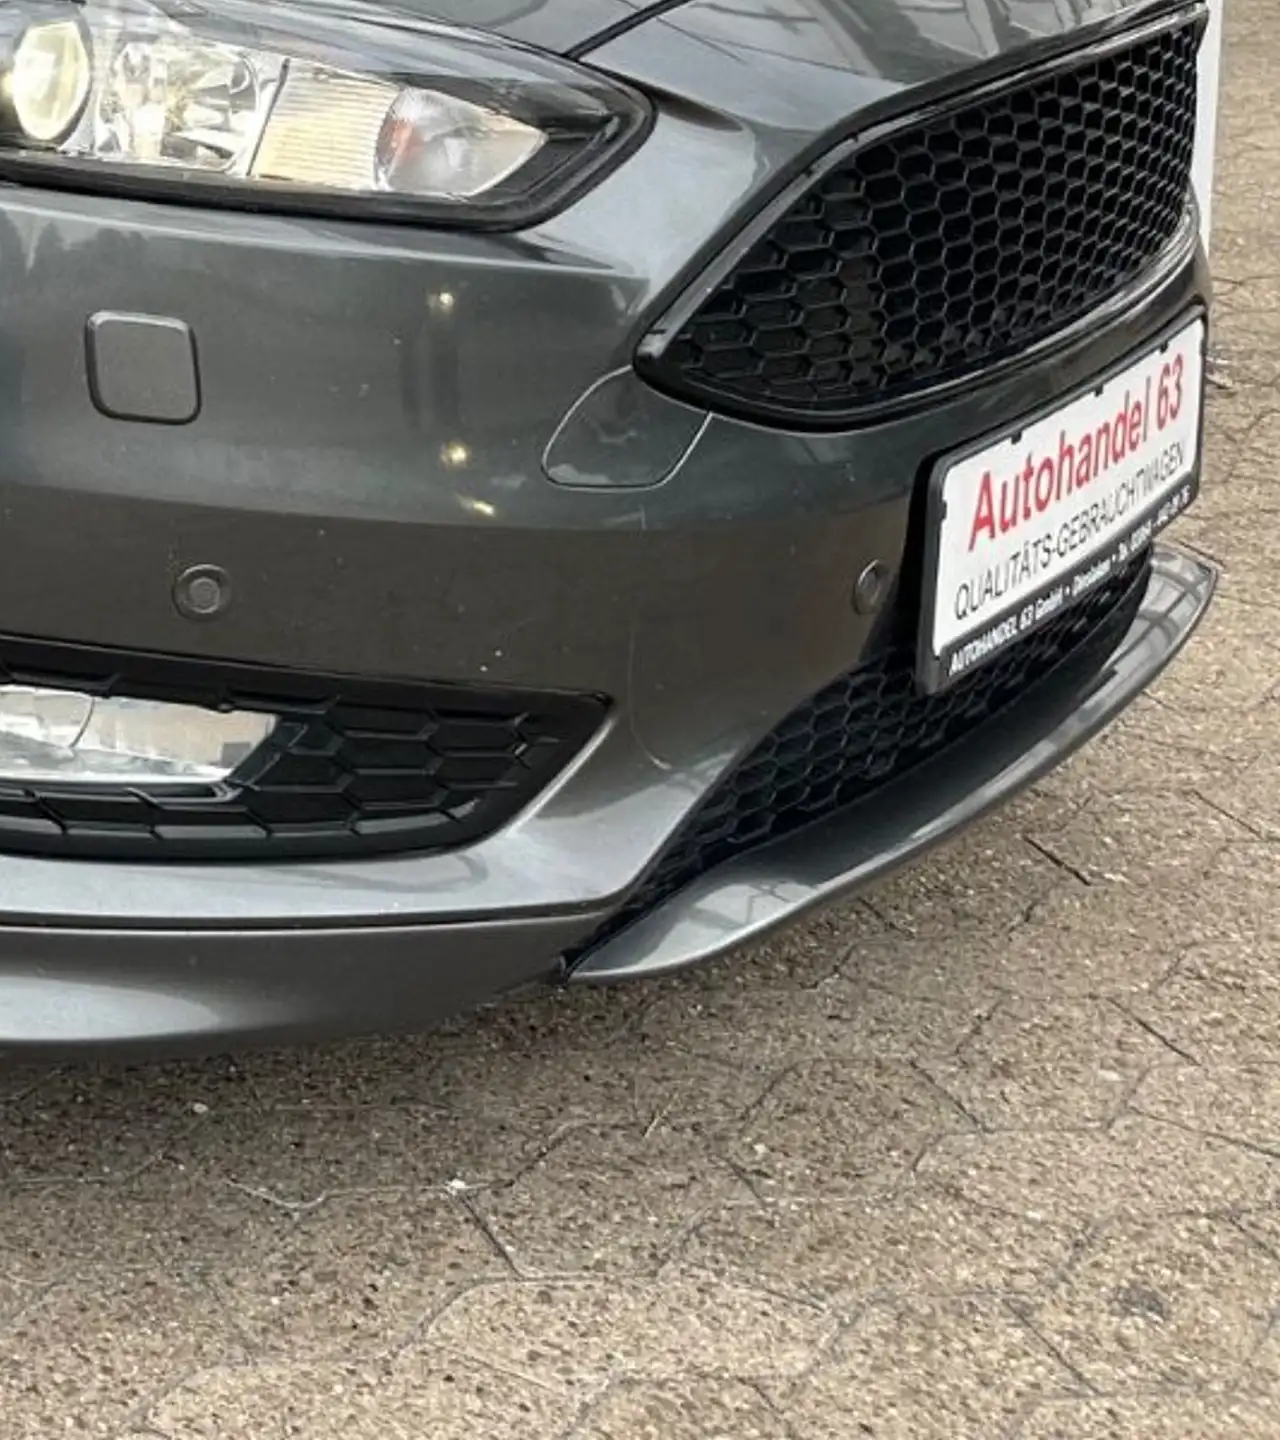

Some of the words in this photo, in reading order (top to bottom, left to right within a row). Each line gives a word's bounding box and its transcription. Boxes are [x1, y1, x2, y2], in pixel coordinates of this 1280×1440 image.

[953, 441, 1185, 621] QUALITÄTS-GEBRAUCHTWAGEN
[968, 375, 1151, 553] Autohandel
[1156, 352, 1184, 431] 63
